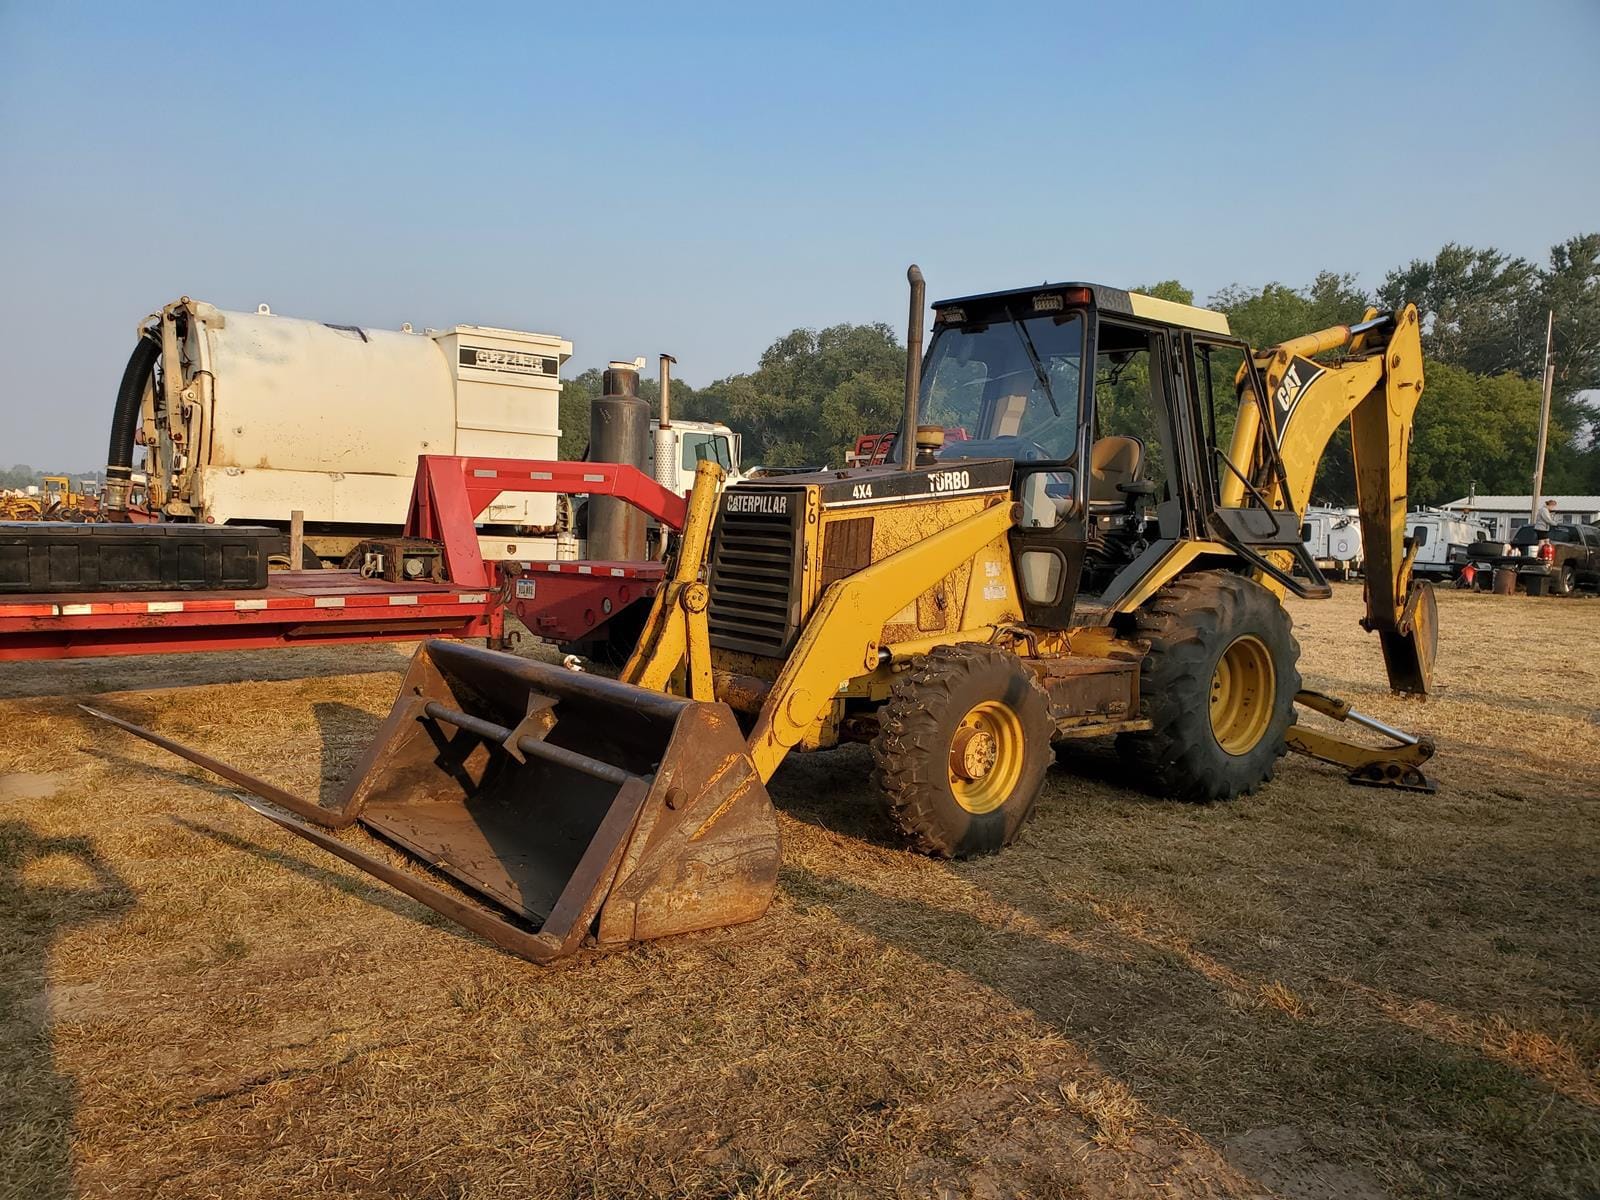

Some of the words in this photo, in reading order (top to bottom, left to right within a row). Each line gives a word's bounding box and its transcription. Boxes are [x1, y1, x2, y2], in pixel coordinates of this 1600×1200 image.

[475, 350, 543, 368] GUZZLER
[1277, 363, 1302, 411] CAT
[928, 471, 970, 491] TURBO
[727, 495, 787, 513] CATERPILLAR
